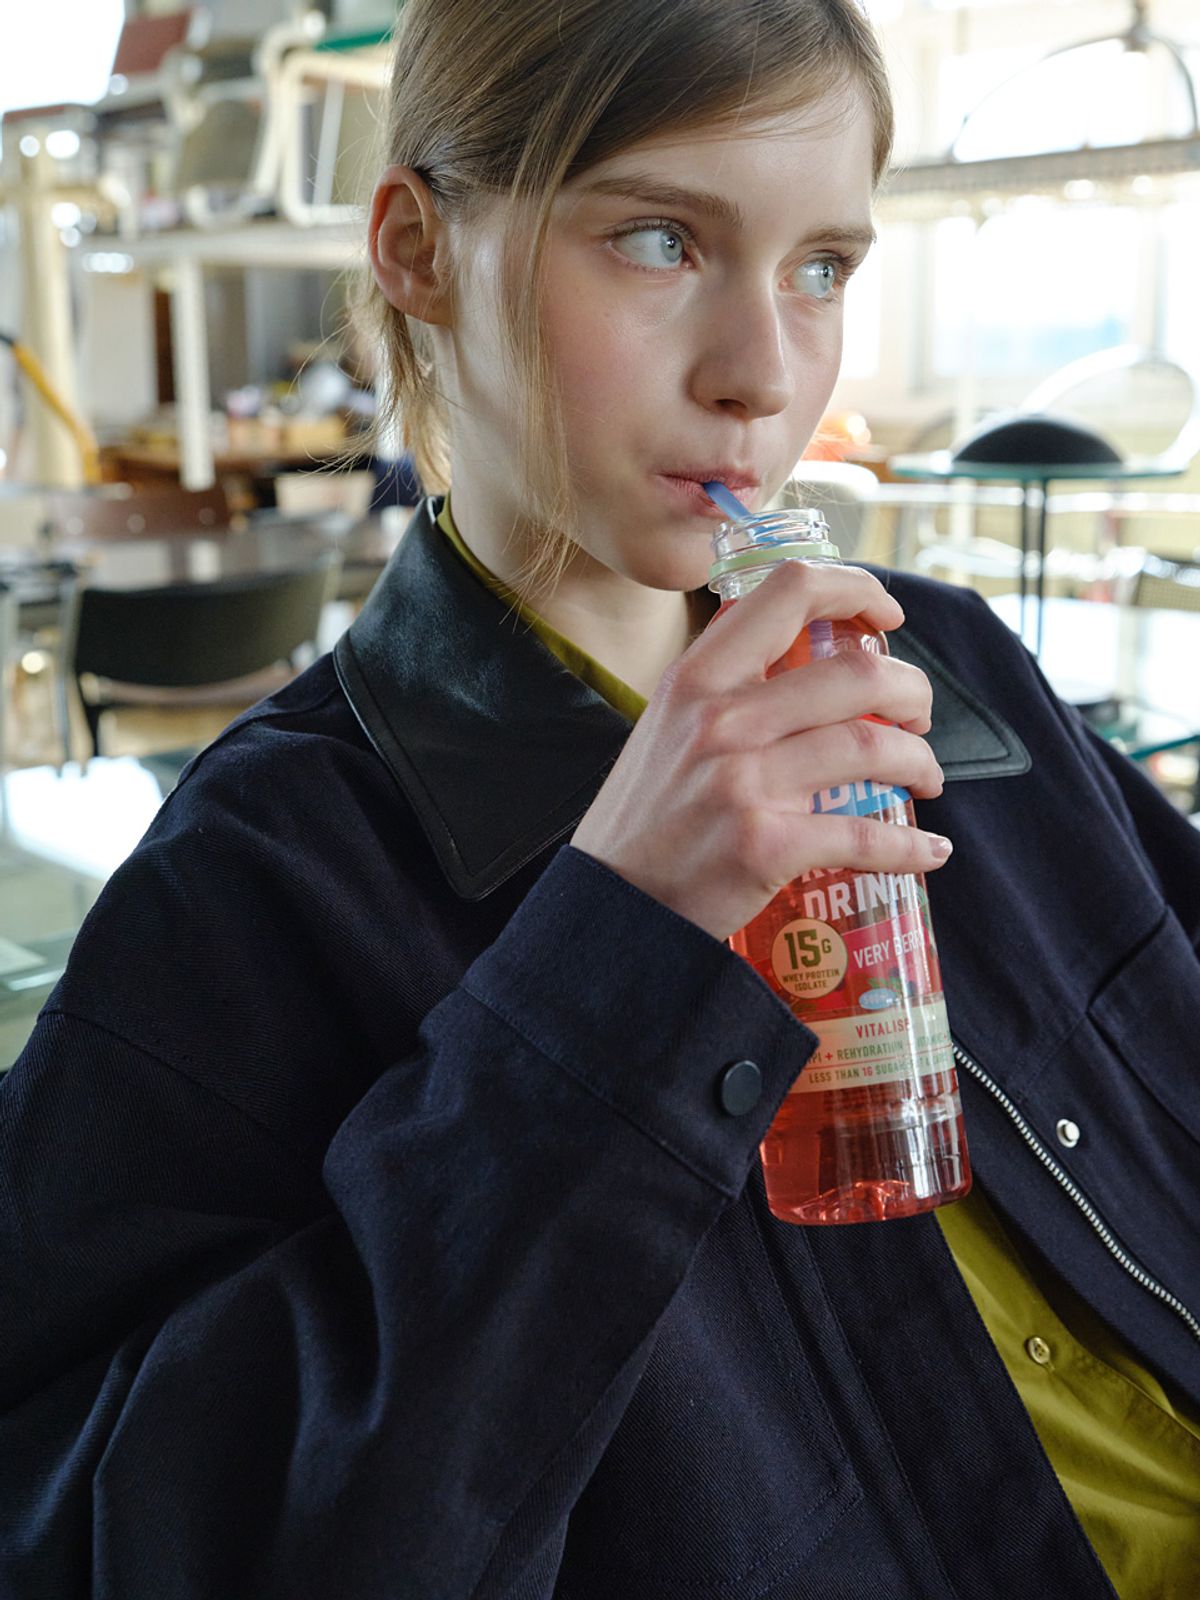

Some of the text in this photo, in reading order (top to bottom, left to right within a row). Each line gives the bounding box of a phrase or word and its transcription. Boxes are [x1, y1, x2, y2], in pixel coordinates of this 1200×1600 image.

[853, 940, 890, 969] VERY
[782, 968, 840, 983] WHEY PROTEIN
[795, 981, 827, 991] ISOLATE
[809, 1072, 831, 1084] LESS
[835, 1068, 859, 1080] THAN
